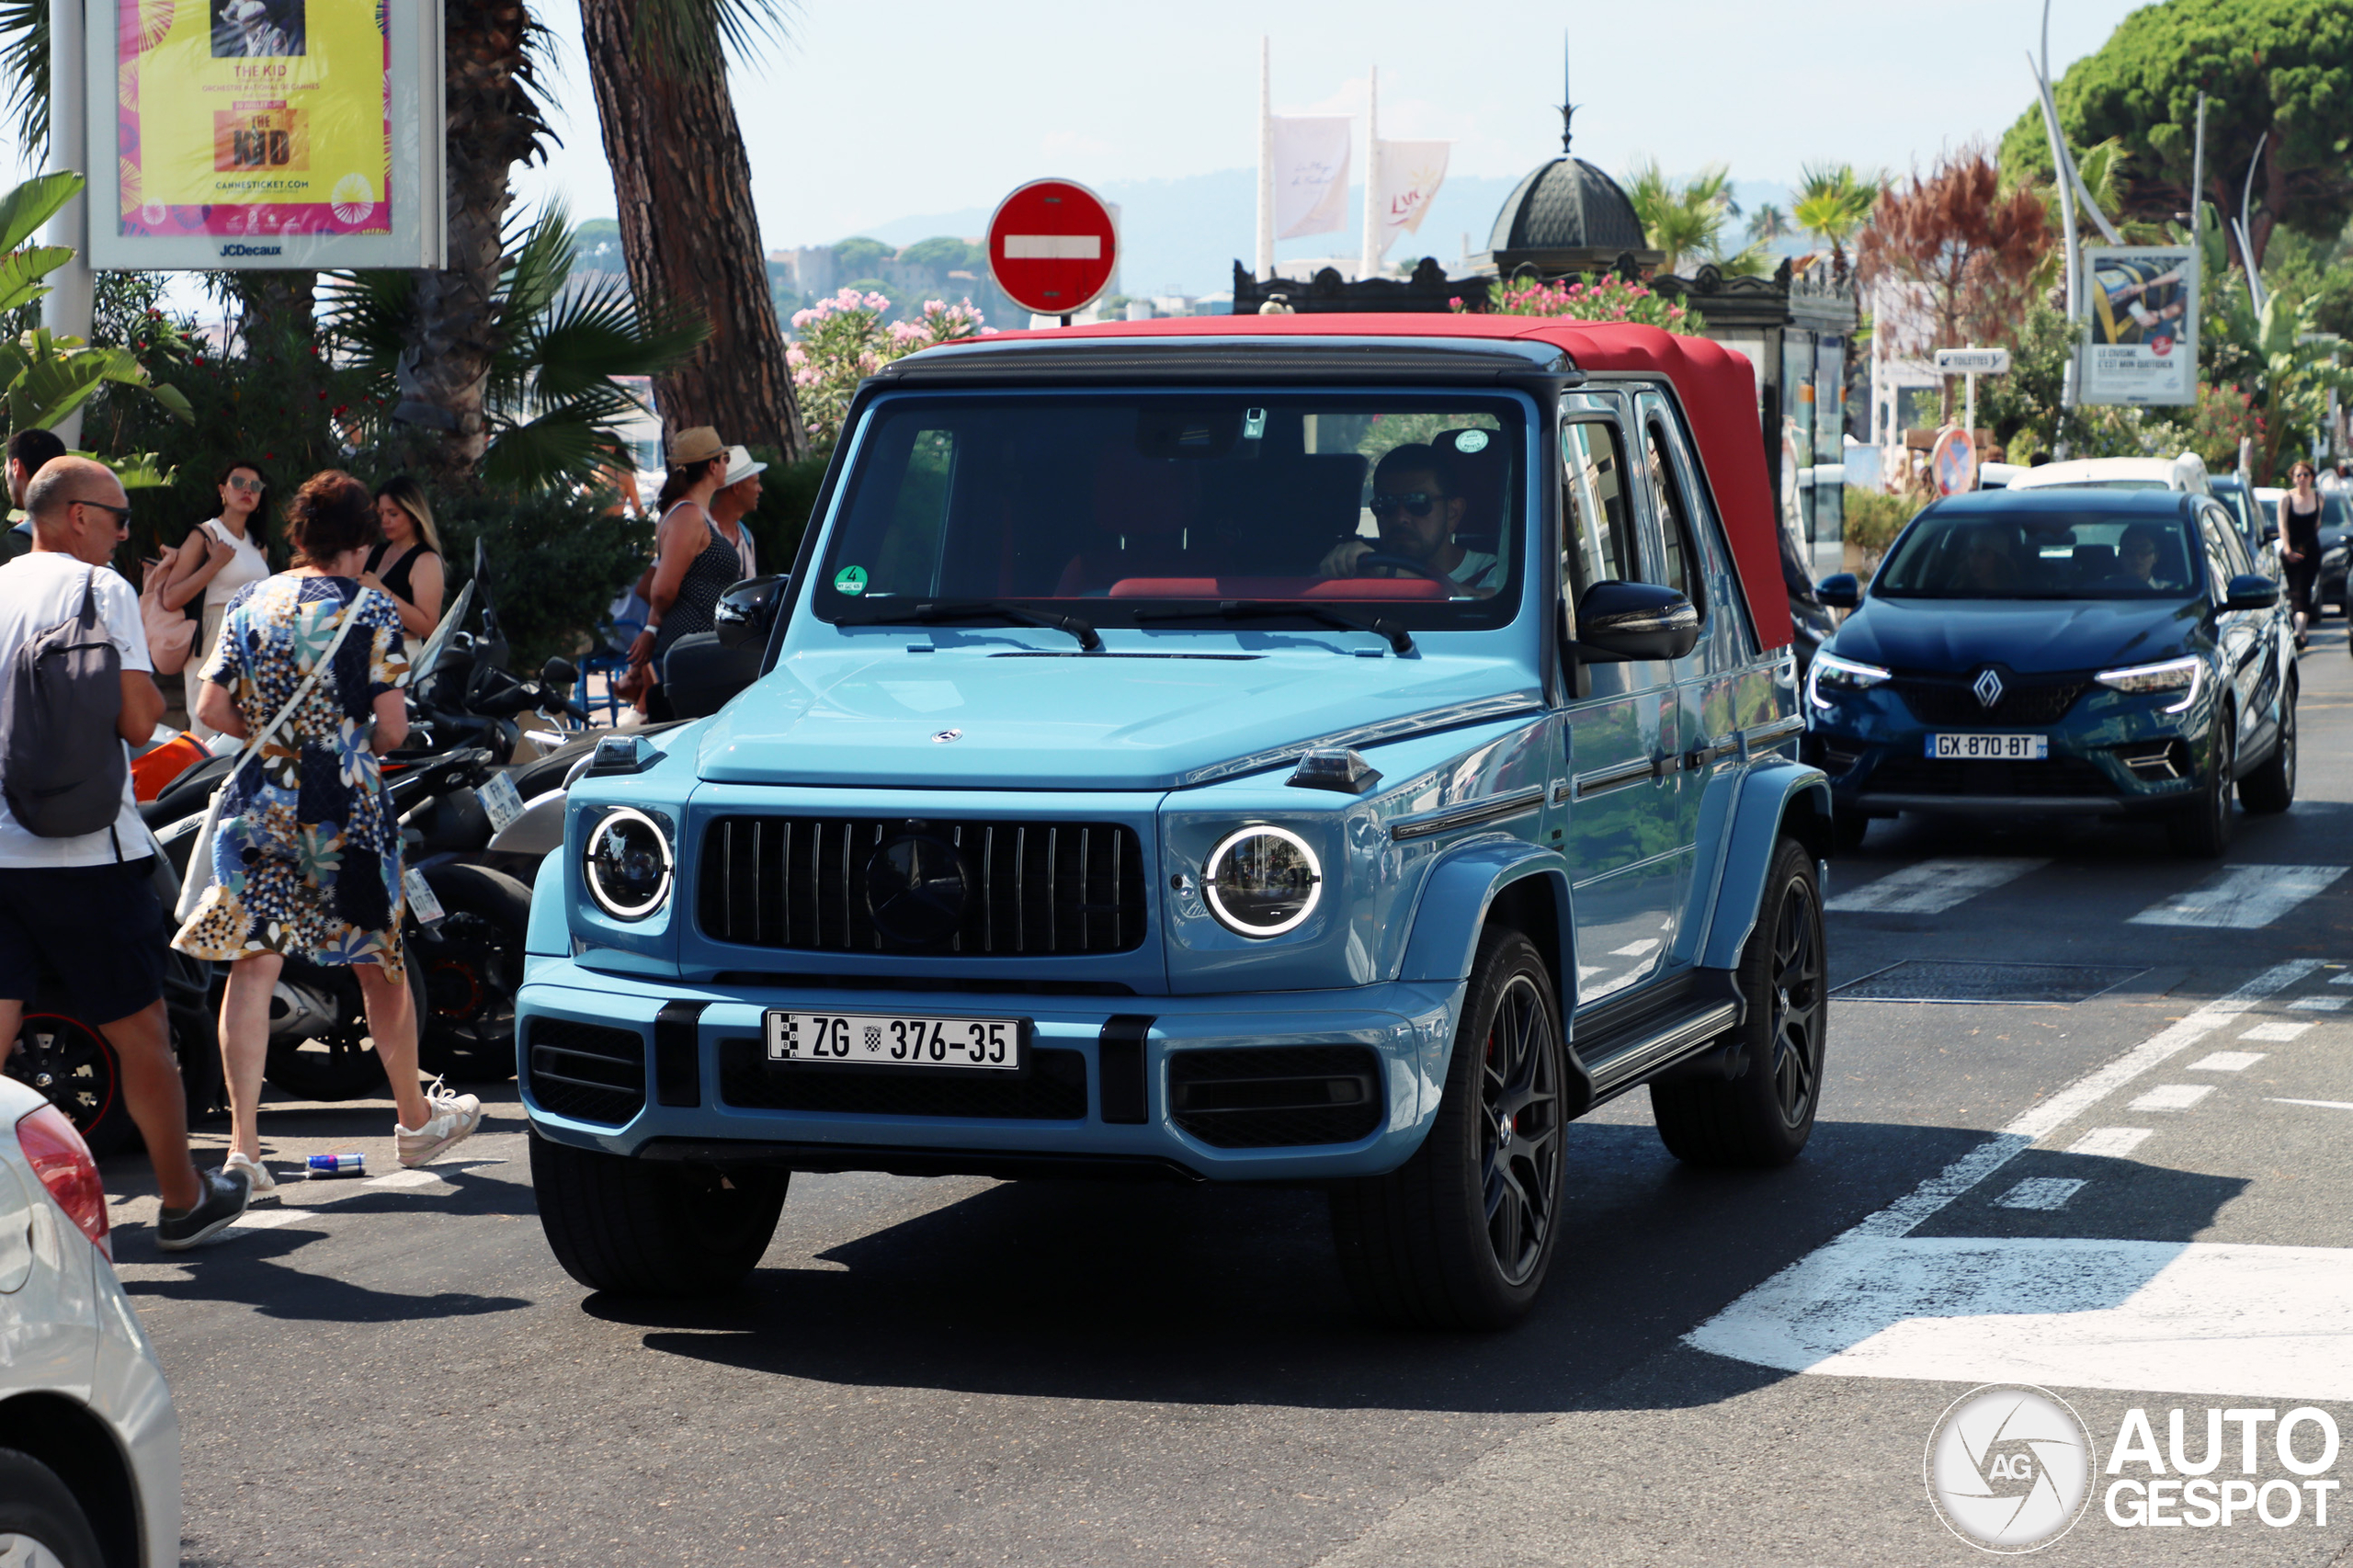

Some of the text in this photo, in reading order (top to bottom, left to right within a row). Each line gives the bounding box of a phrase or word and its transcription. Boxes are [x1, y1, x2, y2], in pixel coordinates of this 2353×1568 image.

[233, 64, 288, 77] THE KID
[201, 82, 320, 92] ORCHESTRE NATIONAL DE CANNES
[252, 115, 270, 128] THE
[233, 130, 290, 165] KID
[215, 180, 309, 190] CANNESTICKET.COM
[220, 244, 281, 256] JCDecaux
[1953, 355, 1988, 366] TOILETTES
[847, 566, 857, 582] 4
[813, 1017, 1006, 1063] ZG 376-35
